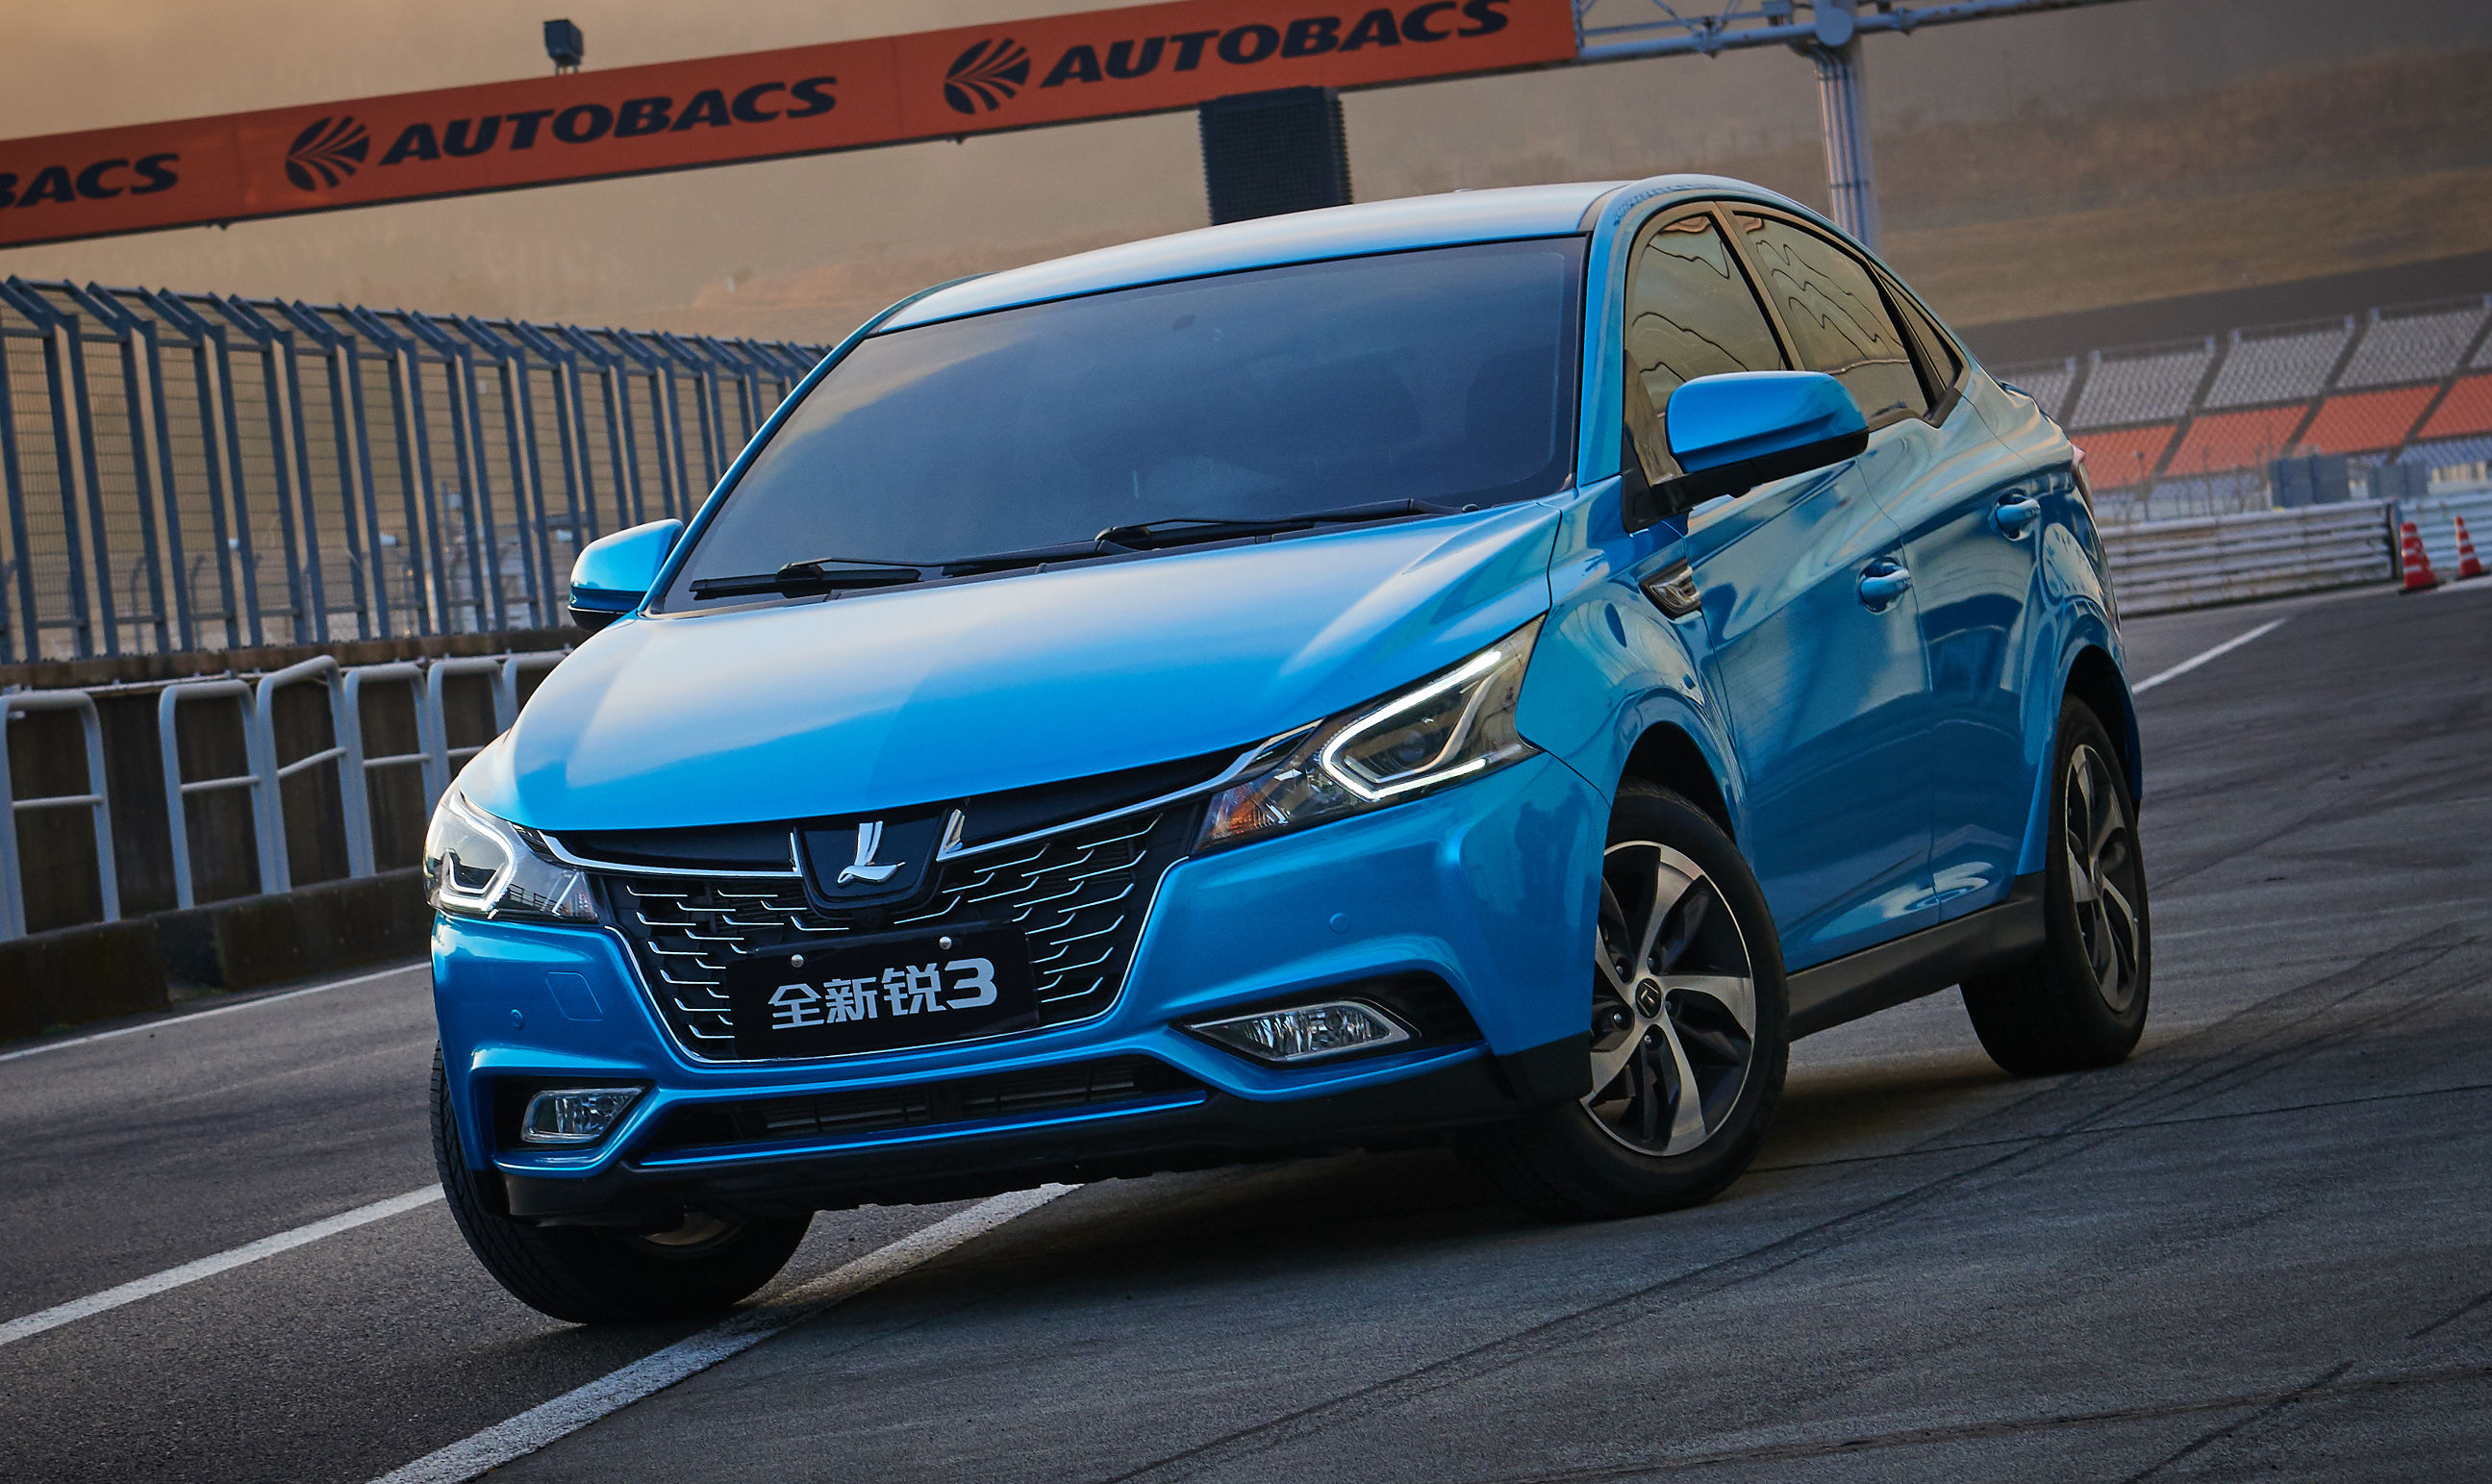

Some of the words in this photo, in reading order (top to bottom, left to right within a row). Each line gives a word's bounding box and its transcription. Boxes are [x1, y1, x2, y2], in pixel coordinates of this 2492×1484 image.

[1040, 0, 1509, 88] AUTOBACS
[378, 76, 837, 165] AUTOBACS
[768, 958, 997, 1030] 全新锐3
